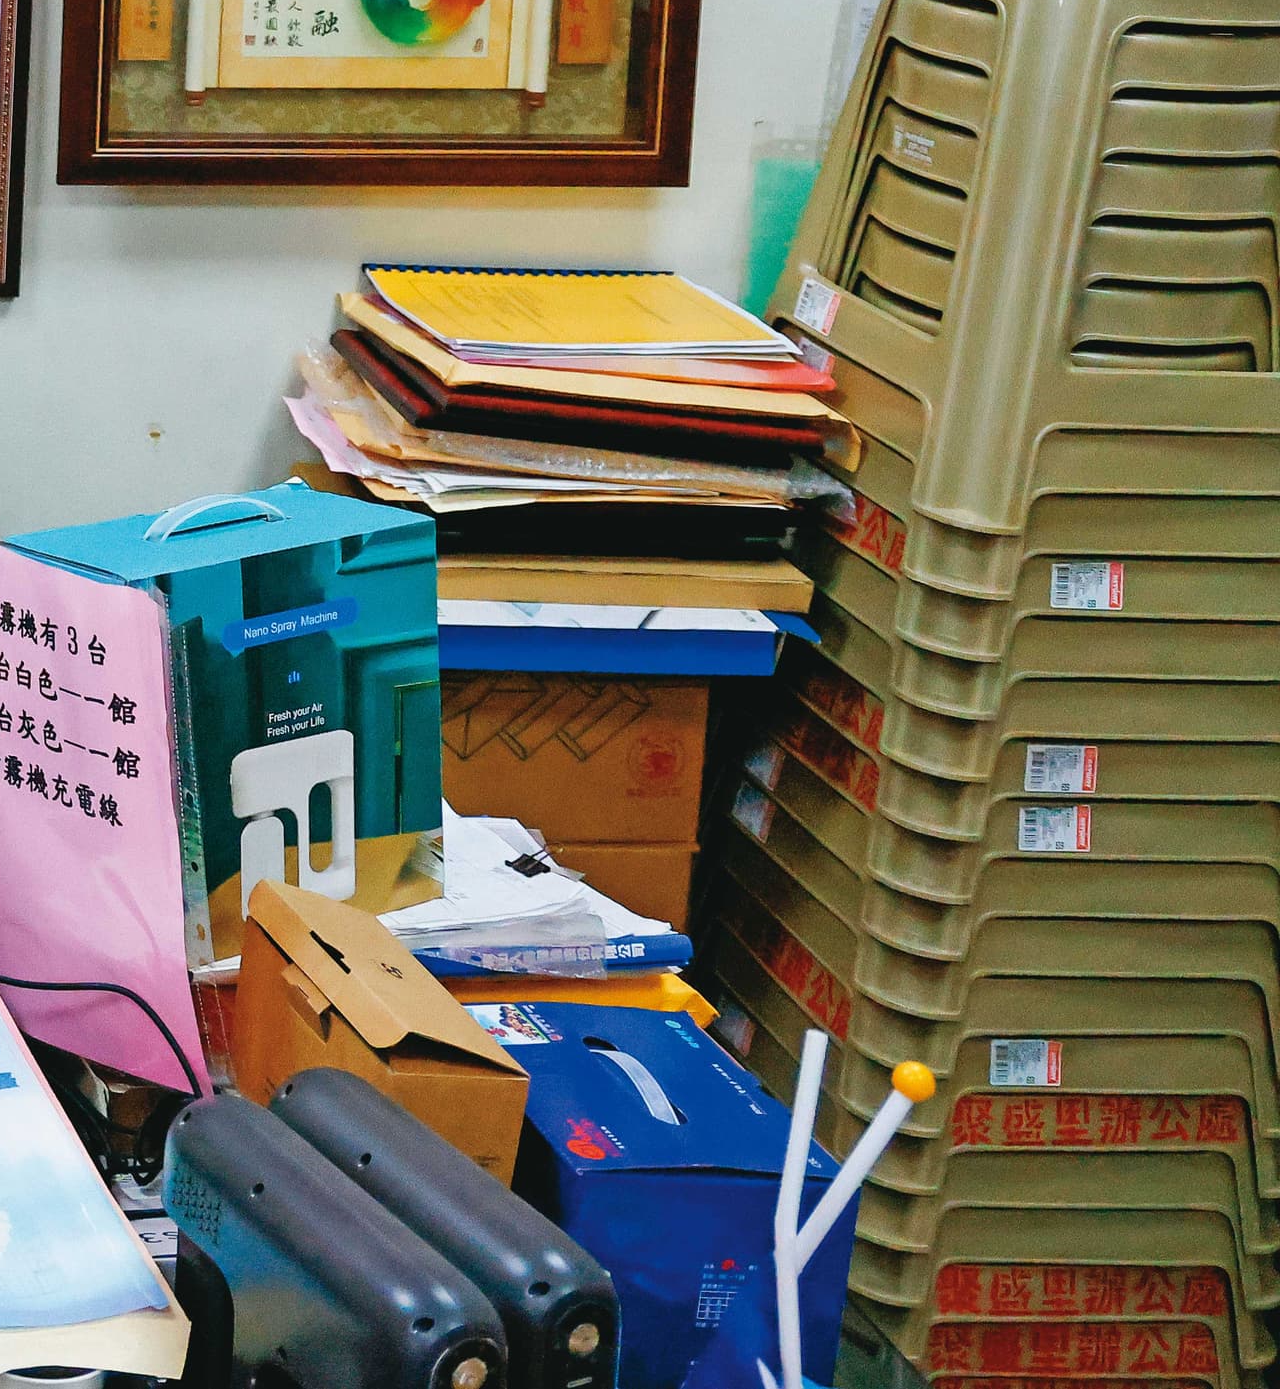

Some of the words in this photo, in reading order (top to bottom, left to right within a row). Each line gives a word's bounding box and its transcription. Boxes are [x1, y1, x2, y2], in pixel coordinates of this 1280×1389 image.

[244, 626, 269, 640] Nano
[270, 618, 298, 635] Spray
[300, 610, 339, 627] Machine
[268, 710, 291, 724] Fresh
[293, 706, 310, 721] your
[311, 702, 324, 713] Air
[266, 724, 290, 738] Fresh
[291, 720, 309, 735] your
[310, 715, 325, 728] Life
